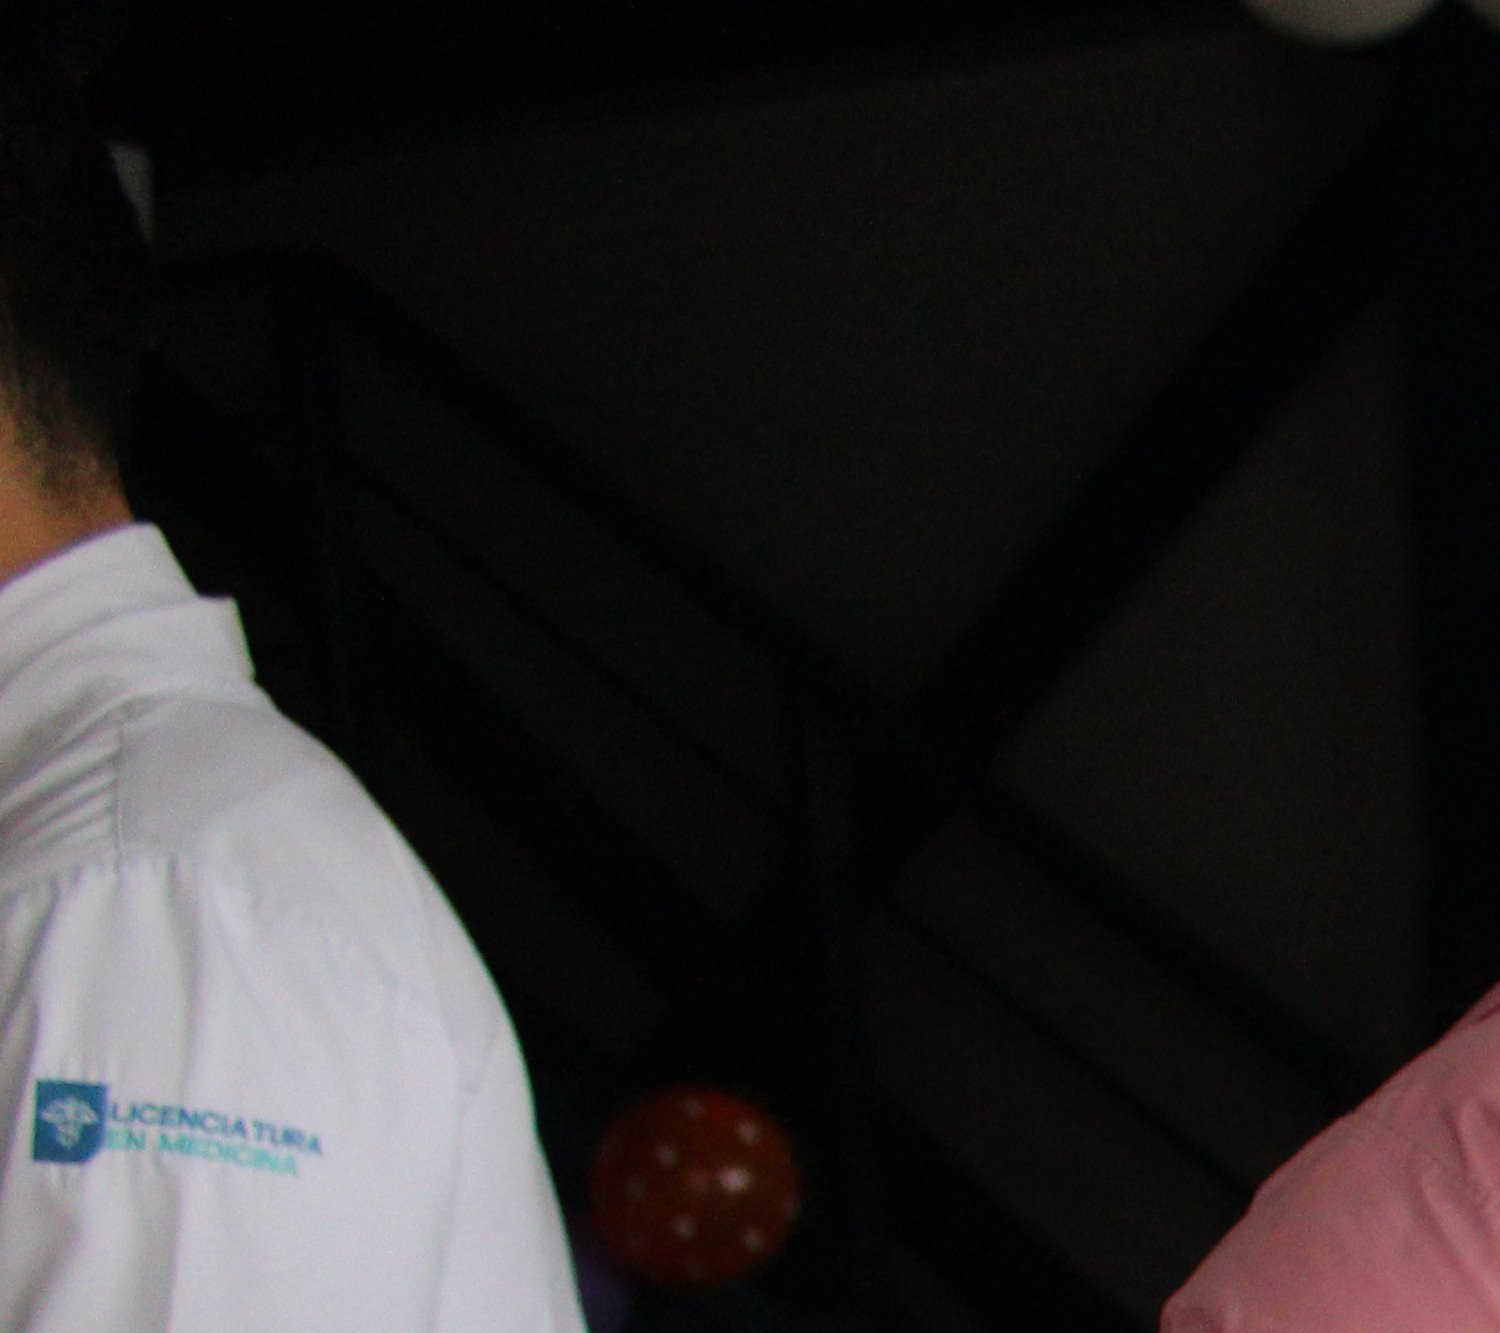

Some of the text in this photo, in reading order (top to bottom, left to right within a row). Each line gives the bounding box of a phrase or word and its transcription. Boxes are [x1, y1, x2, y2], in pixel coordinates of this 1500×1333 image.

[106, 1127, 298, 1178] EN MEDICINA
[111, 1102, 322, 1155] LICENCIATURA
